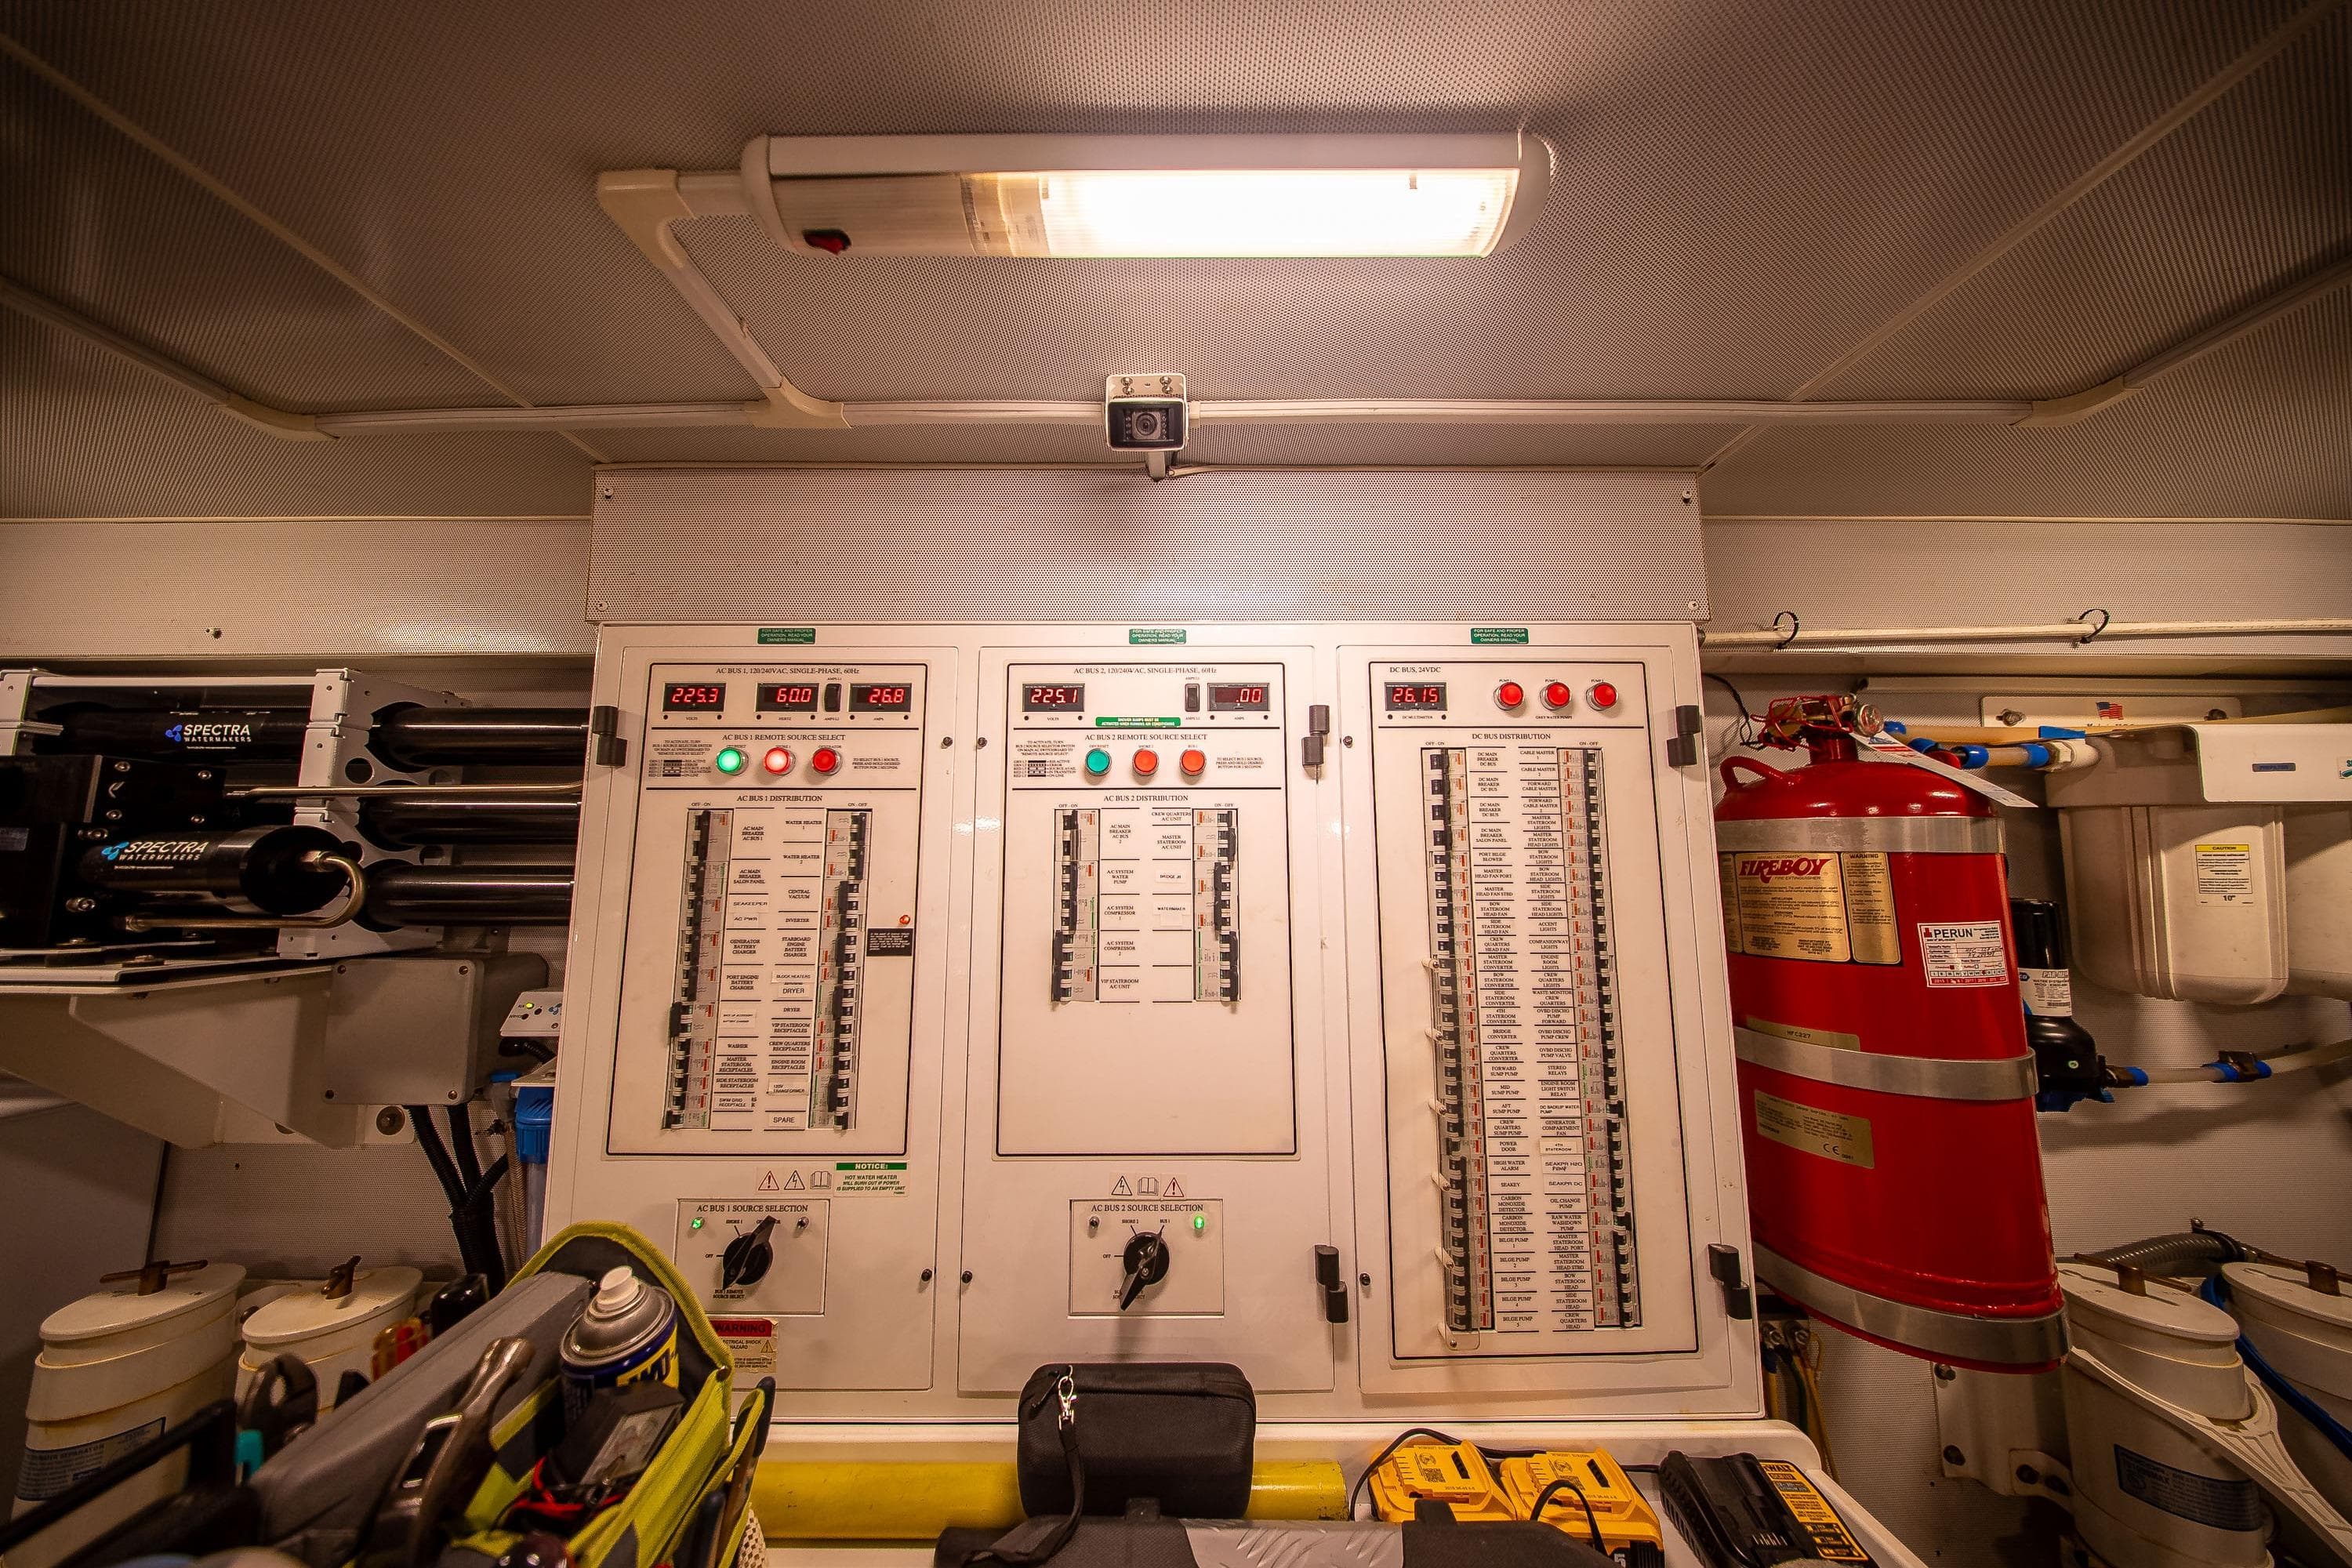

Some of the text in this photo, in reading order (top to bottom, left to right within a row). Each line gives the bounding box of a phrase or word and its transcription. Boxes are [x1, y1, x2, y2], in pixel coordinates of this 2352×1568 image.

[1392, 688, 1442, 702] 26.15
[183, 724, 251, 735] SPECTRA
[125, 841, 209, 853] SPECTRA
[1739, 858, 1833, 884] FIREBOY
[1933, 928, 1973, 938] PERUN
